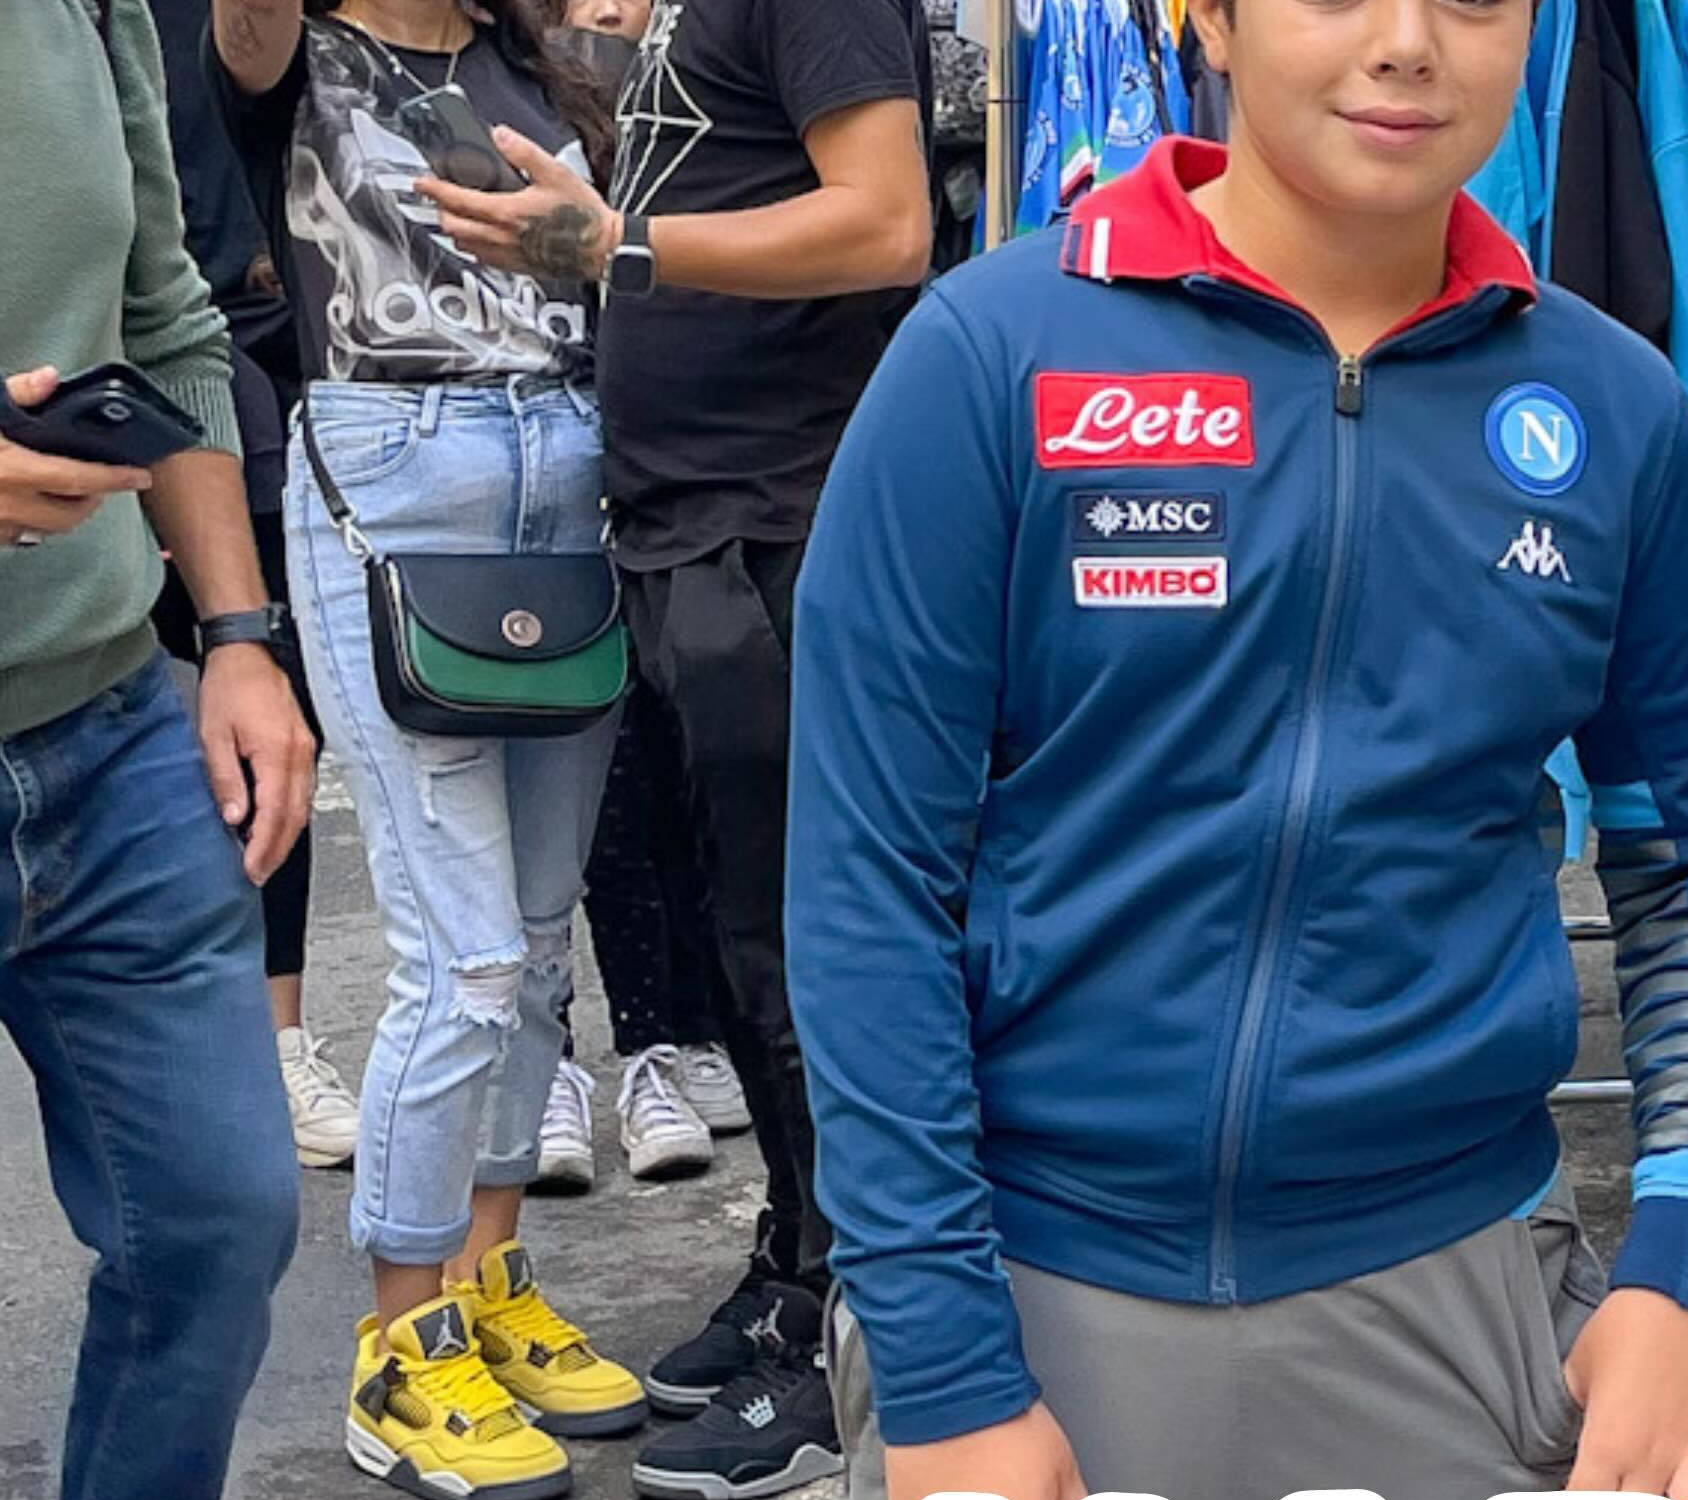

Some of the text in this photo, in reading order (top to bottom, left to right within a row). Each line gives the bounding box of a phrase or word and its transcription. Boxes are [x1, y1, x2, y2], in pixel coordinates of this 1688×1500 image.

[1045, 386, 1243, 452] Lete
[1517, 410, 1564, 466] N
[1126, 502, 1212, 532] MSC
[1082, 564, 1219, 597] KIMBO
